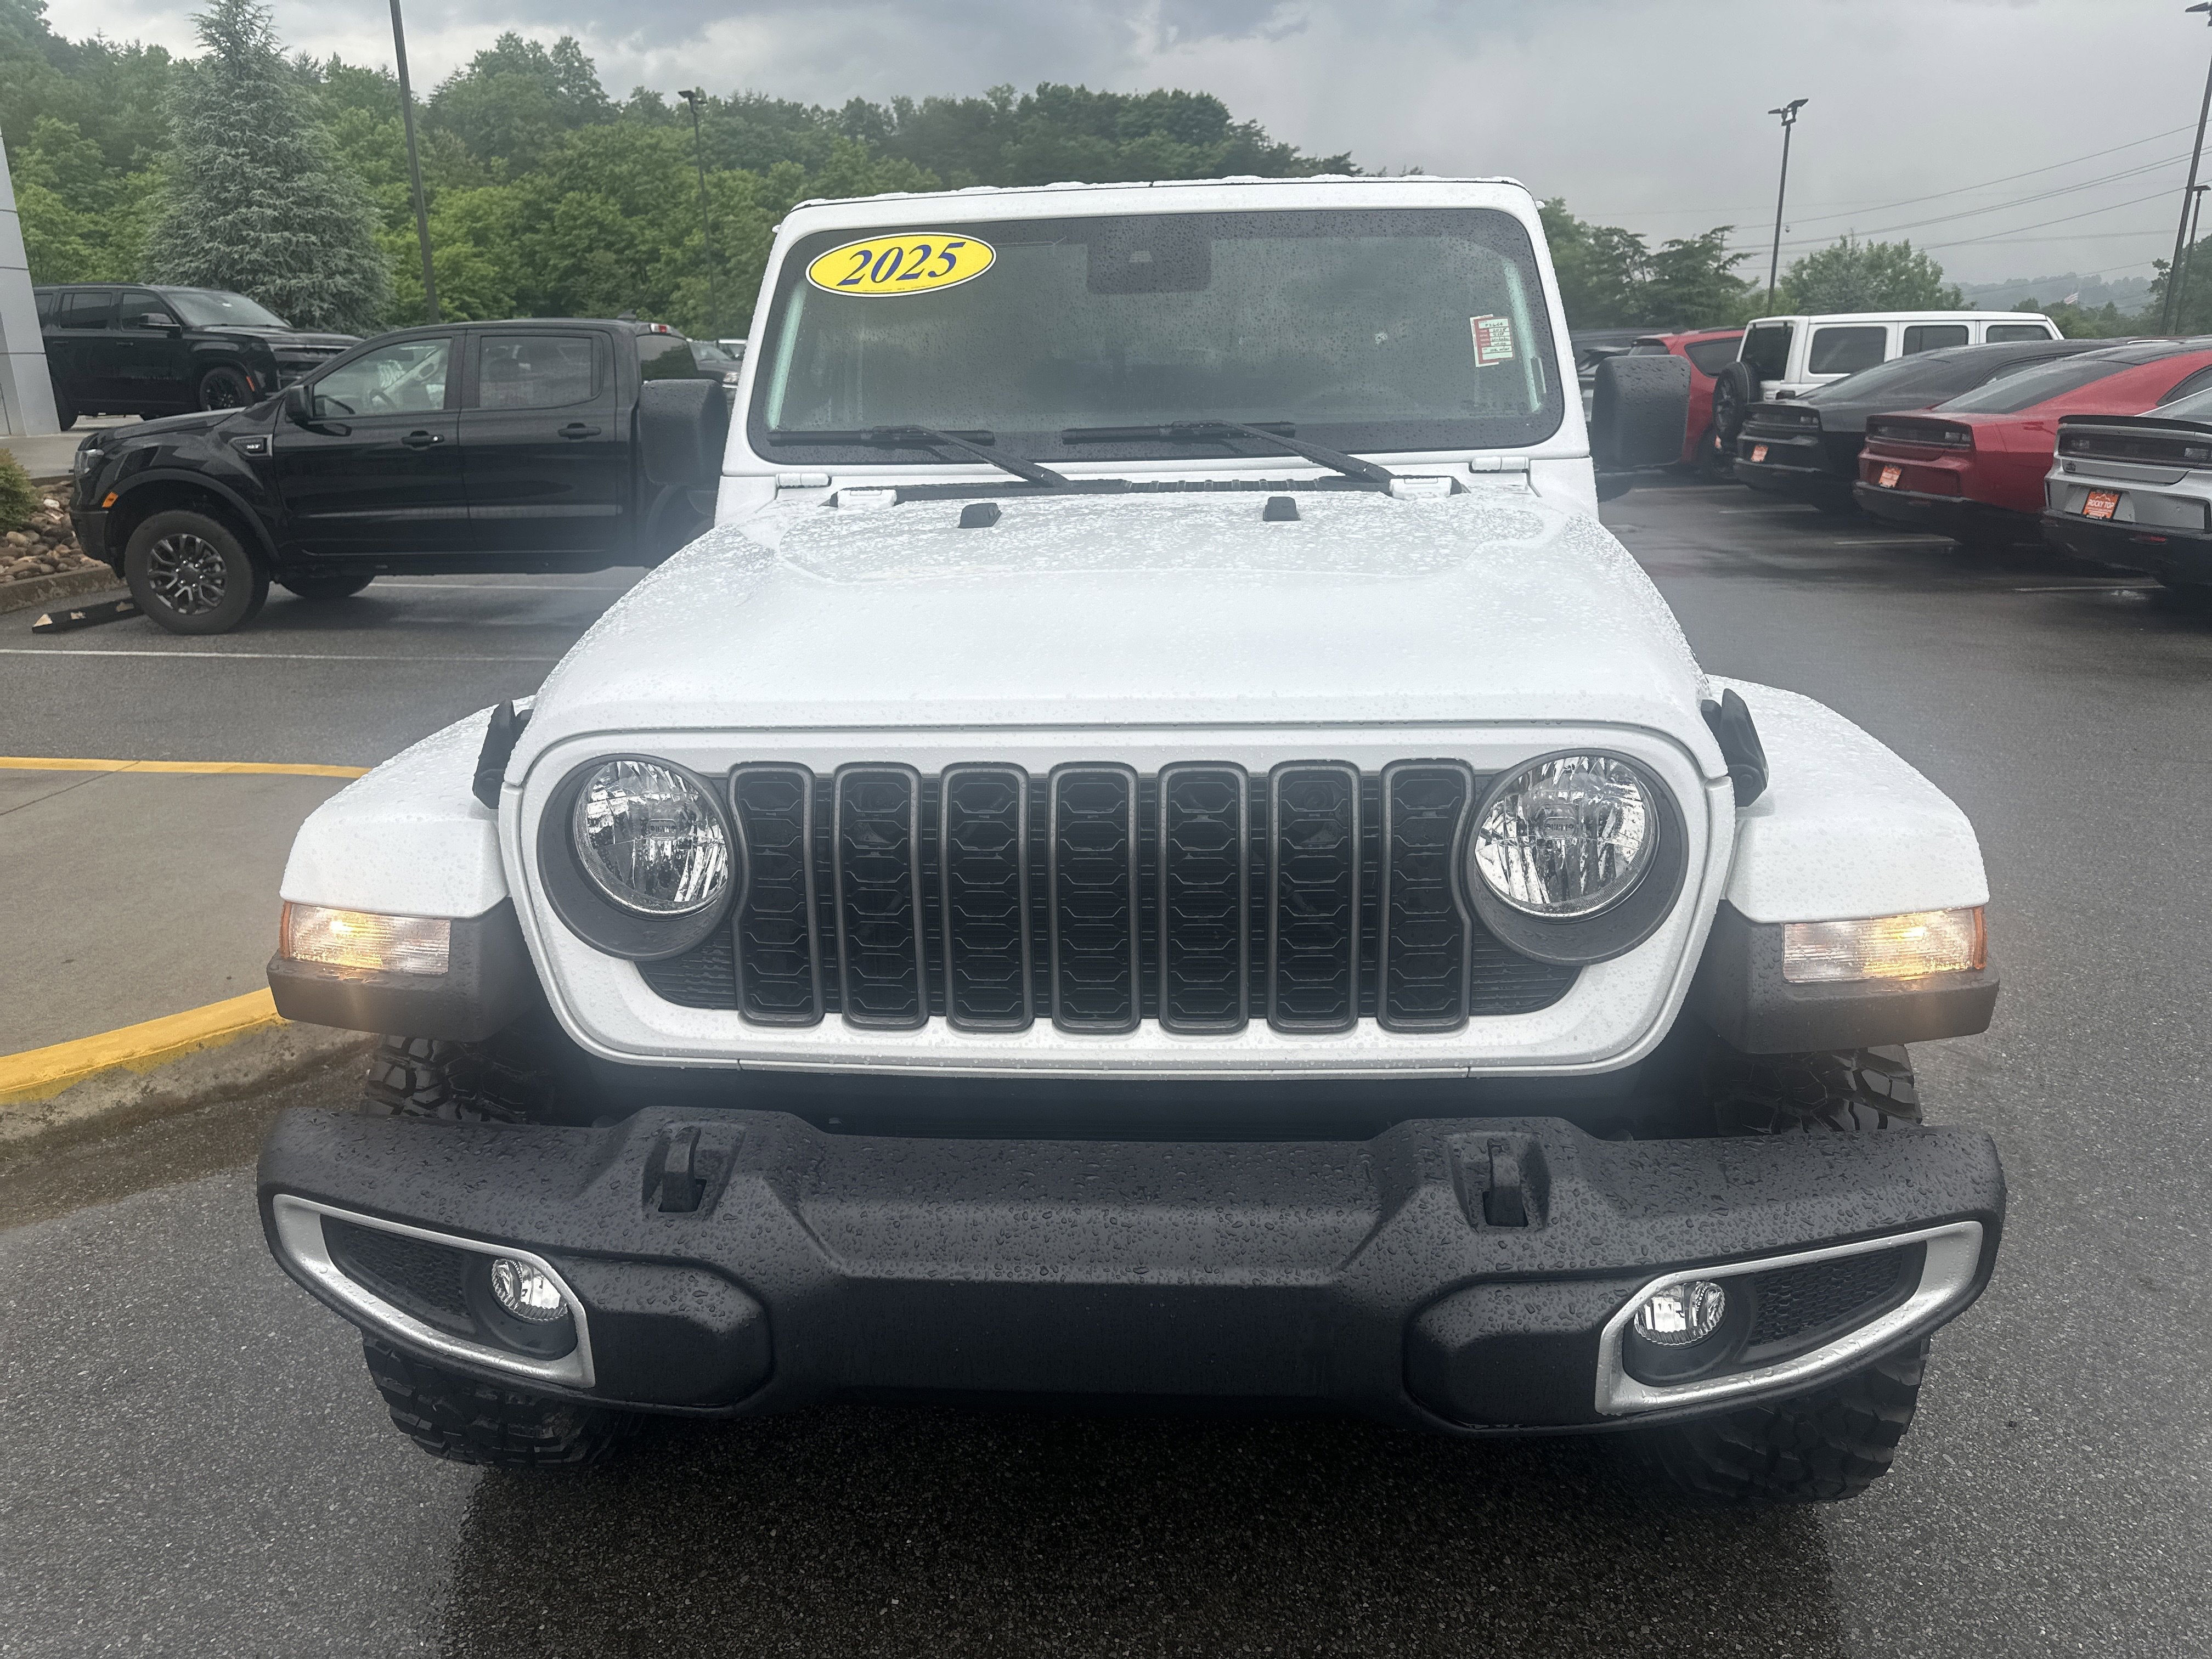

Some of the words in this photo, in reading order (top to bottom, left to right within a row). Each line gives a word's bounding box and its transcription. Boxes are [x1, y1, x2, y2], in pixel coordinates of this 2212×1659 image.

[837, 241, 966, 286] 2025
[2087, 499, 2104, 507] ROCKY
[2104, 501, 2114, 509] TOP
